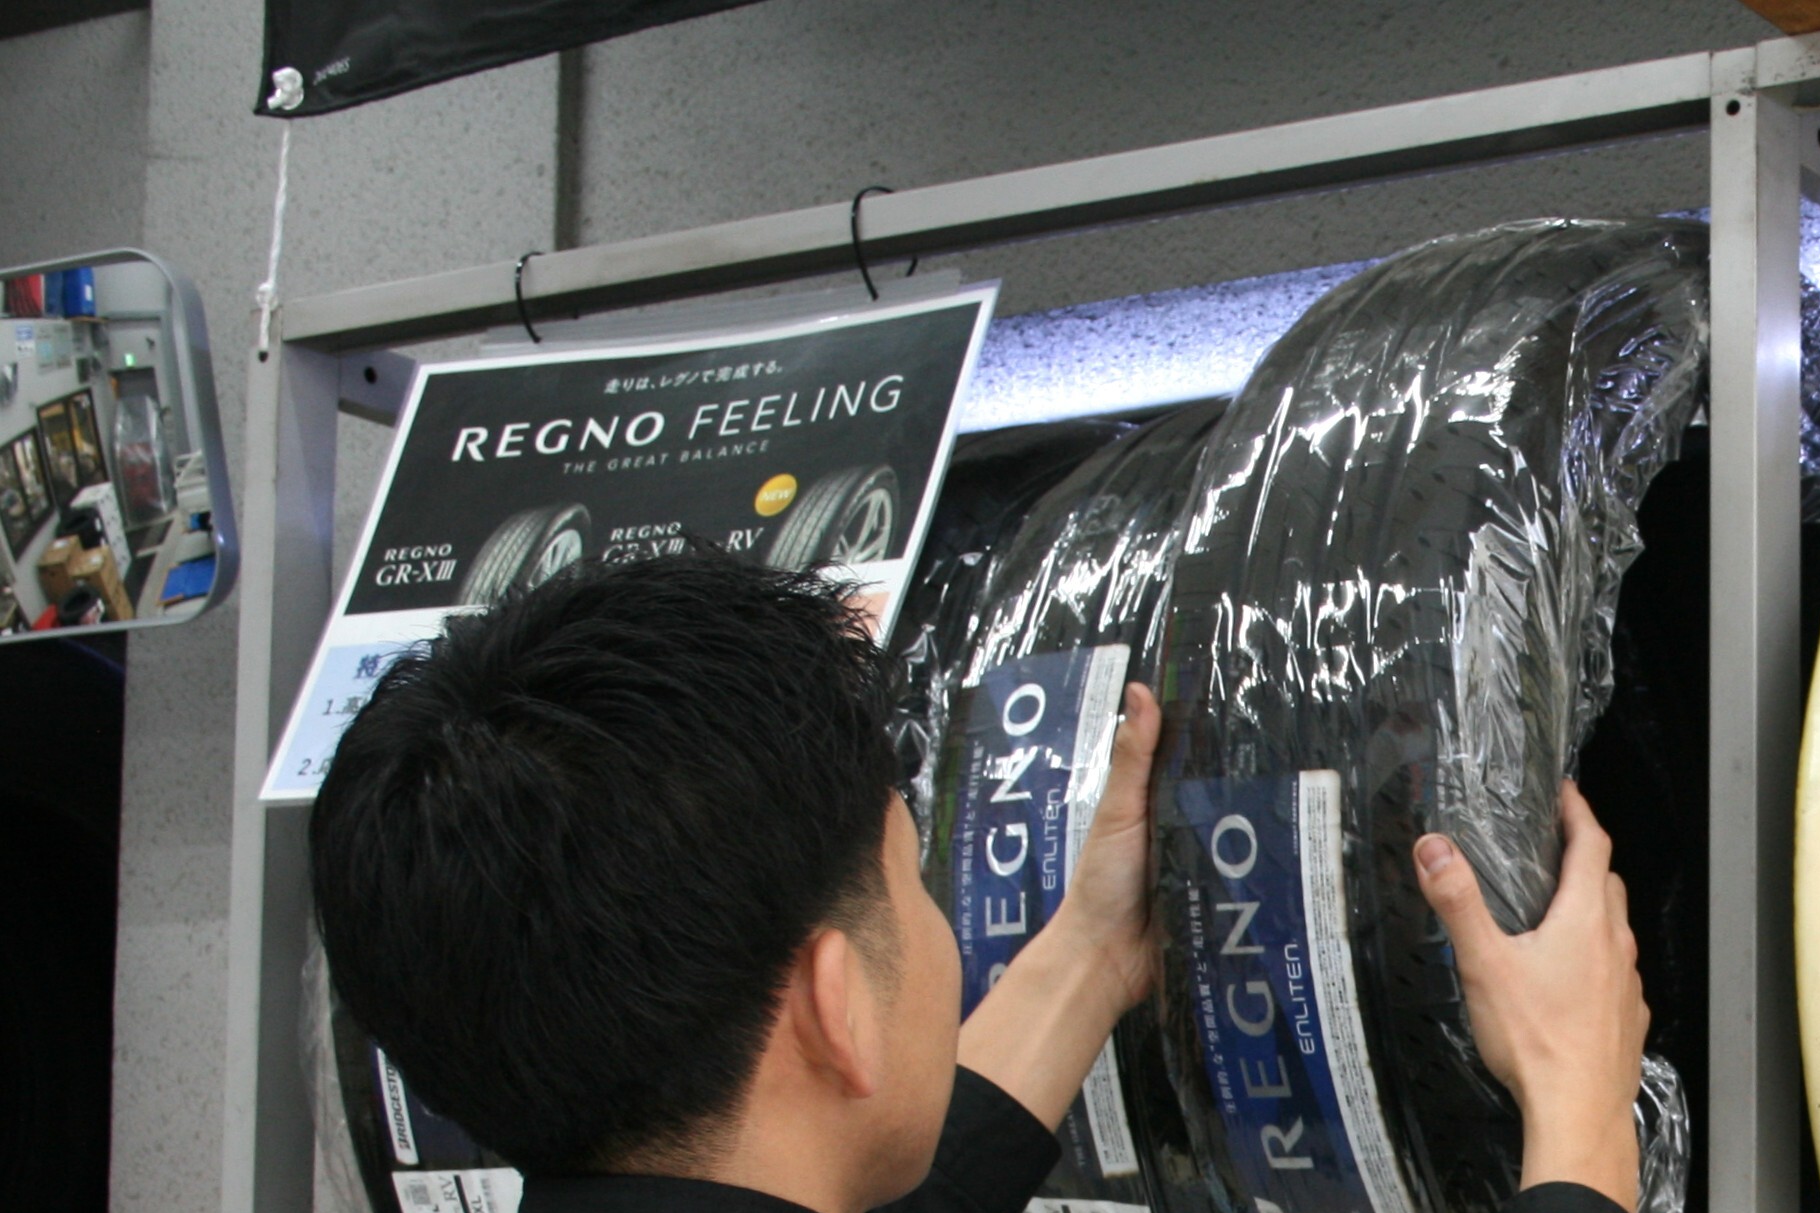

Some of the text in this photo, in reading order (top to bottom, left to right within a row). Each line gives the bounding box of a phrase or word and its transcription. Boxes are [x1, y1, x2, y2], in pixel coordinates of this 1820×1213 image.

[452, 374, 905, 462] REGNO FEELING
[563, 439, 771, 476] THE GREAT BALANCE
[384, 543, 453, 562] REGNO
[610, 520, 682, 543] REGNO
[984, 682, 1048, 990] EGNO
[1212, 813, 1315, 1172] REGNO
[387, 1064, 411, 1151] BRIDGESTO
